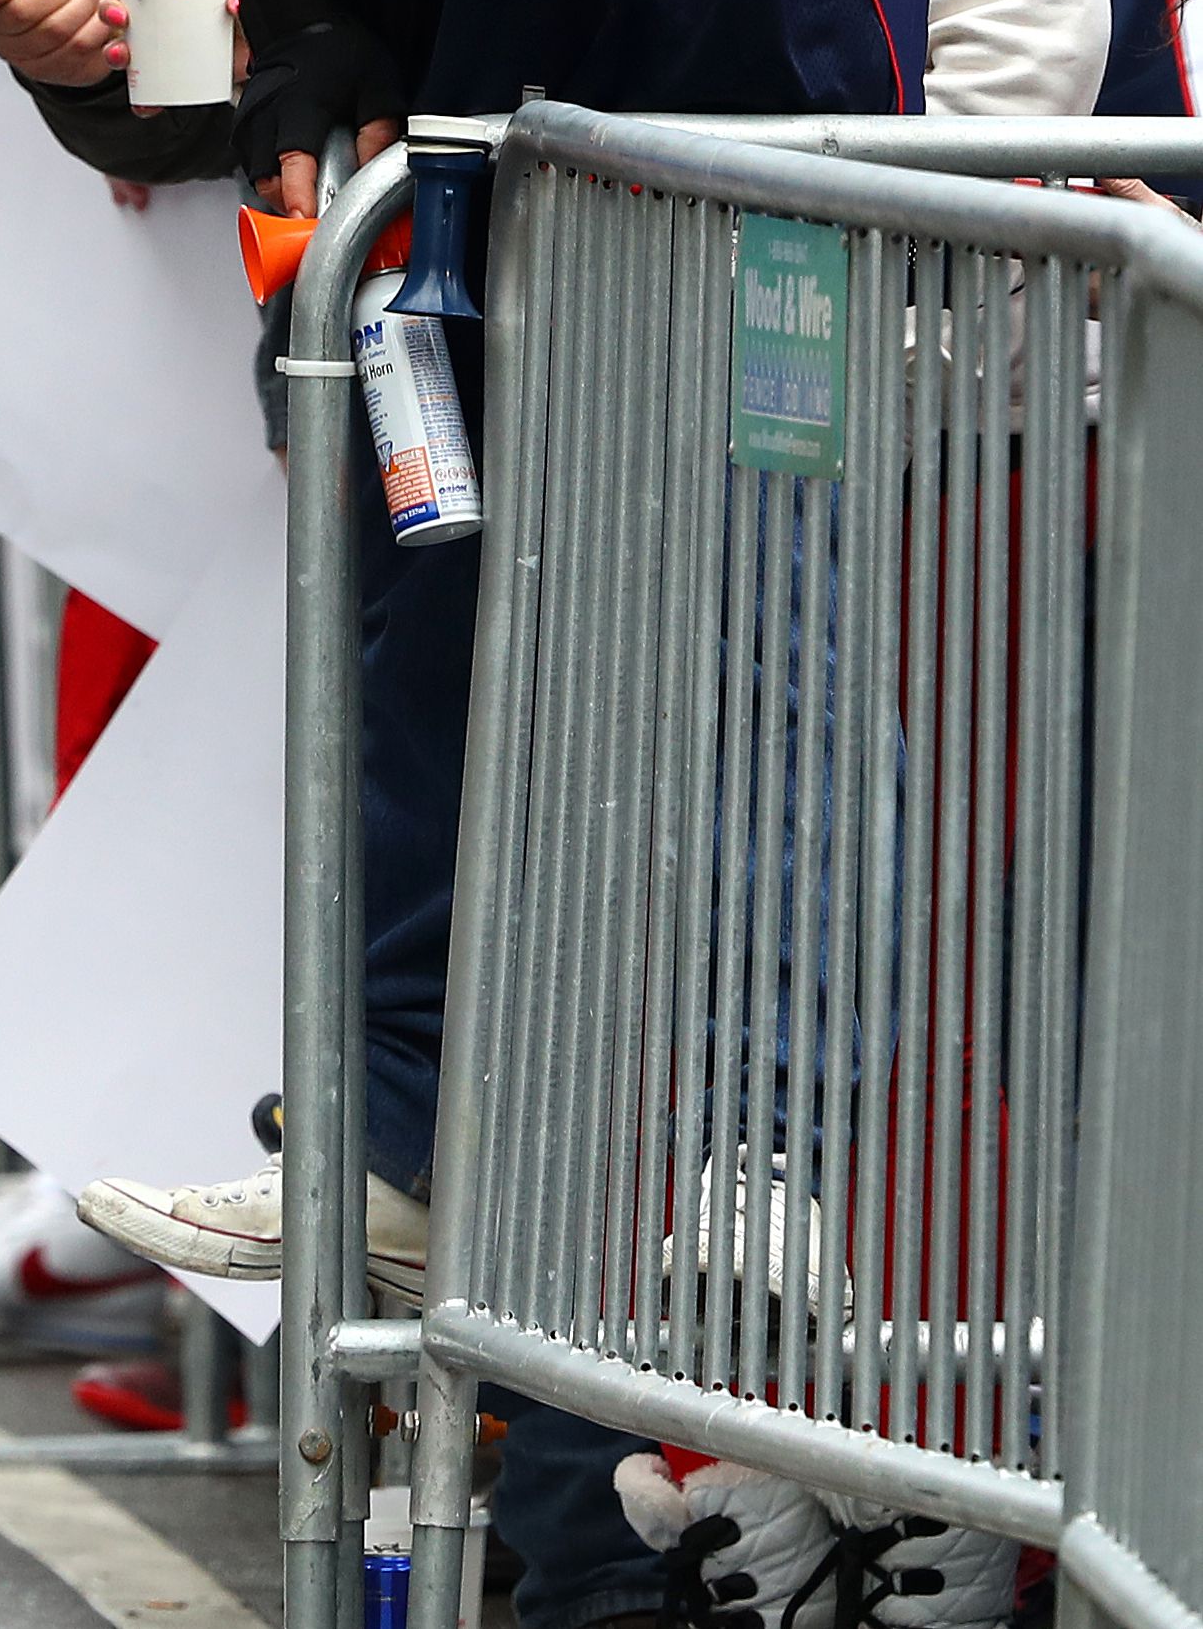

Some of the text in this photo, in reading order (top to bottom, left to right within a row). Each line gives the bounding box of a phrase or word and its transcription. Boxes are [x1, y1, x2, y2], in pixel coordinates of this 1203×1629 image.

[745, 268, 832, 341] Wood & Wire
[369, 362, 394, 381] Horn
